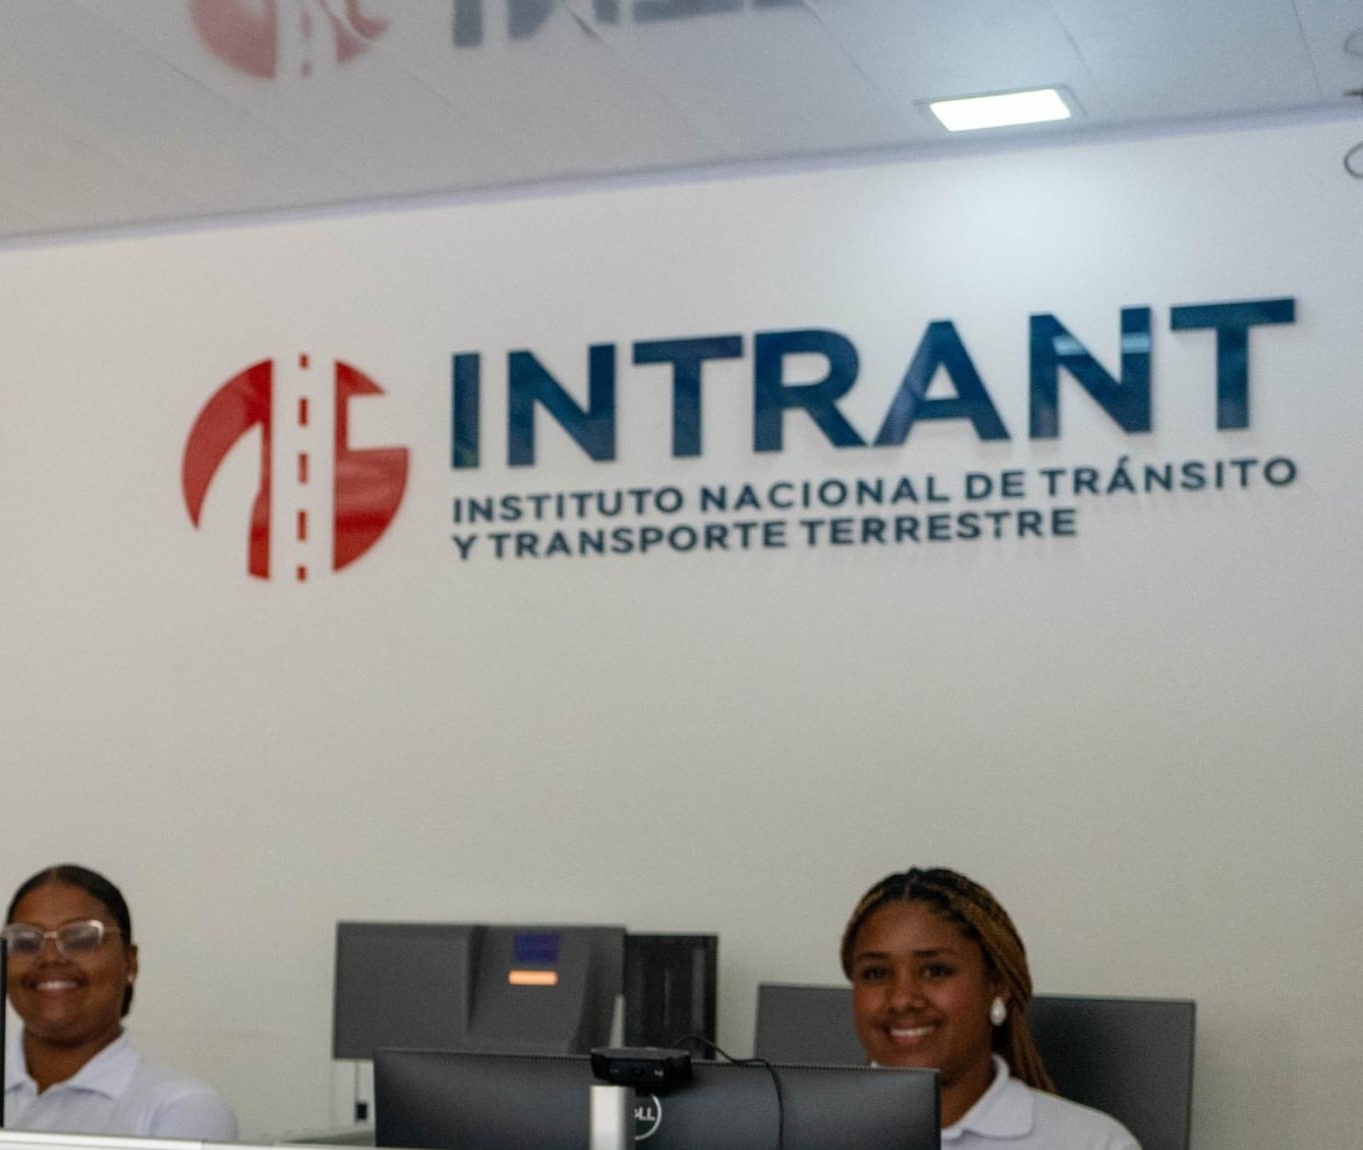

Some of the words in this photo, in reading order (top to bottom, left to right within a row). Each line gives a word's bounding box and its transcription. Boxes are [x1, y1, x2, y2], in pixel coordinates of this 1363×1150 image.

[451, 297, 1296, 469] INTRANT
[452, 485, 685, 525] INSTITUTO
[699, 475, 950, 513] NACIONAL
[965, 469, 1026, 501] DE
[1039, 456, 1298, 497] TRÁNSITO
[452, 534, 478, 561] Y
[487, 519, 787, 560] TRANSPORTE
[799, 508, 1078, 547] TERRESTRE
